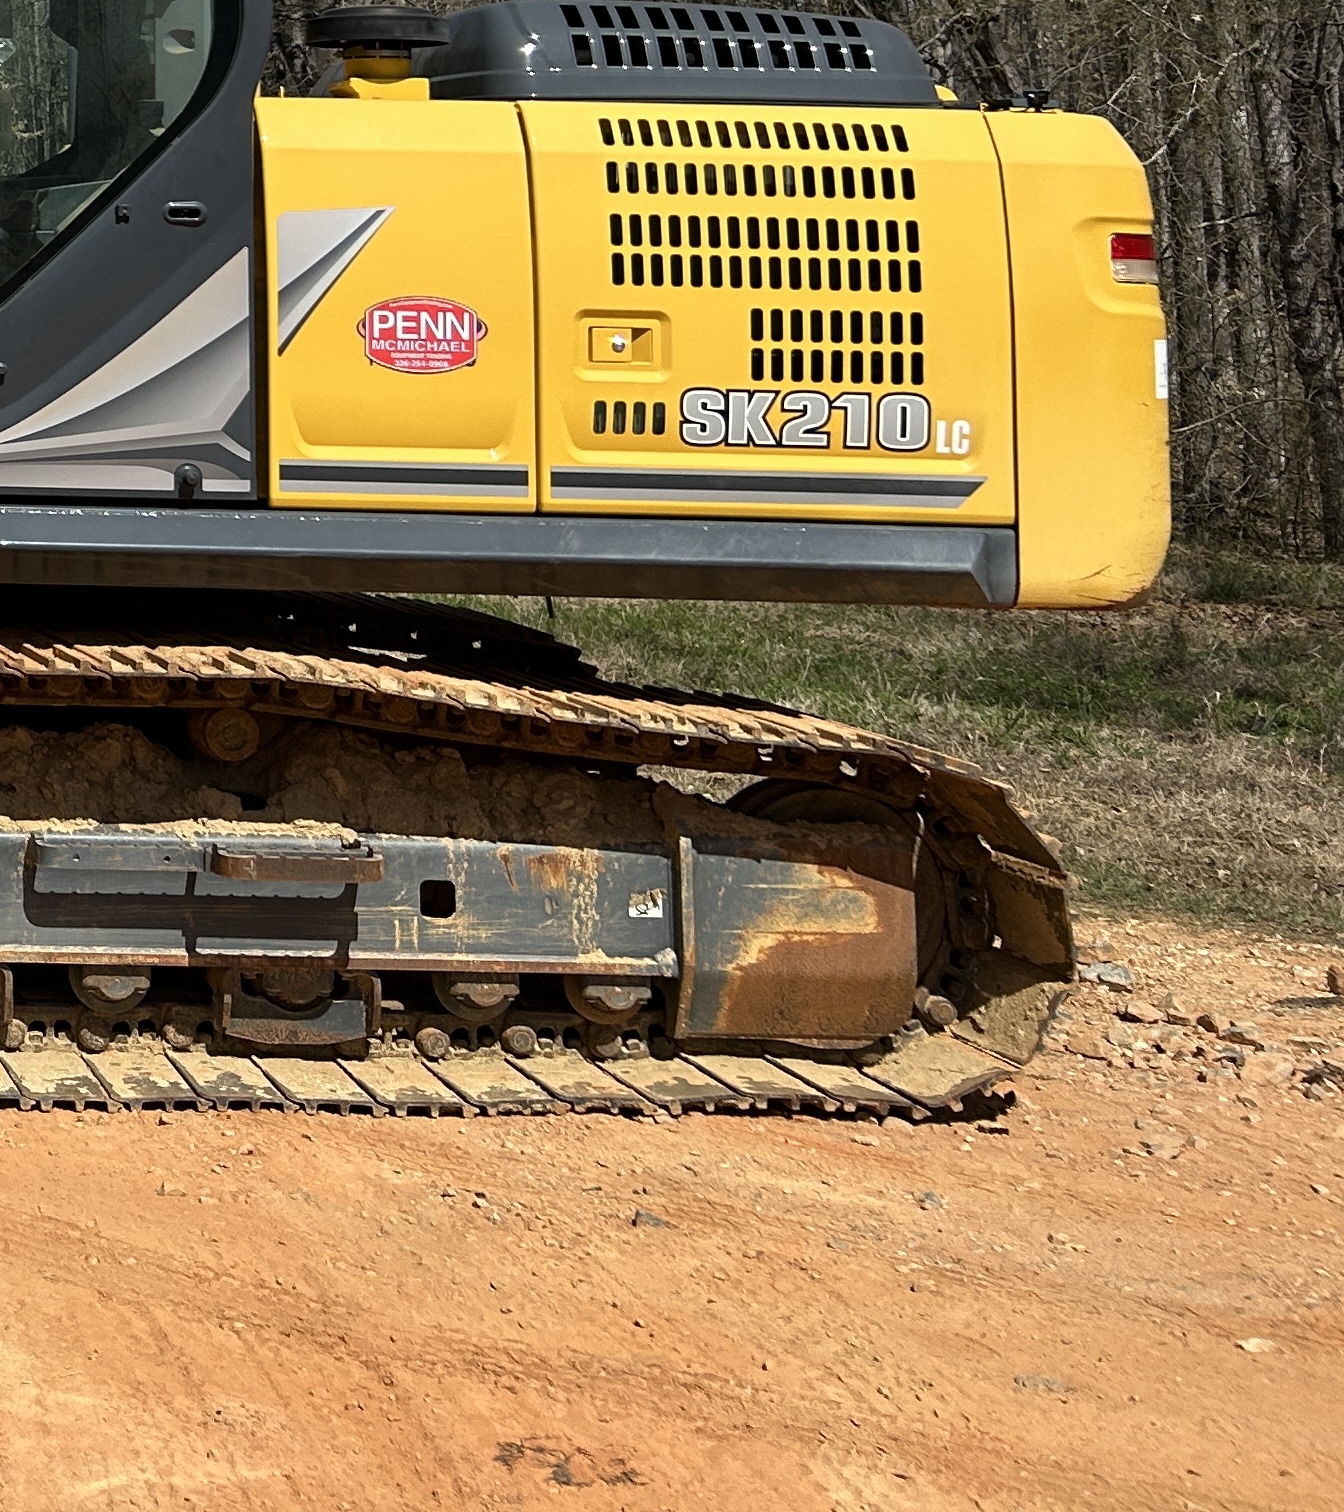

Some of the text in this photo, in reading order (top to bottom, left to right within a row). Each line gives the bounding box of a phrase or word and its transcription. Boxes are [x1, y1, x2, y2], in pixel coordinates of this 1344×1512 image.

[372, 309, 471, 341] PENN
[372, 339, 471, 353] MCMICHAEL
[680, 386, 971, 455] SK210 LC
